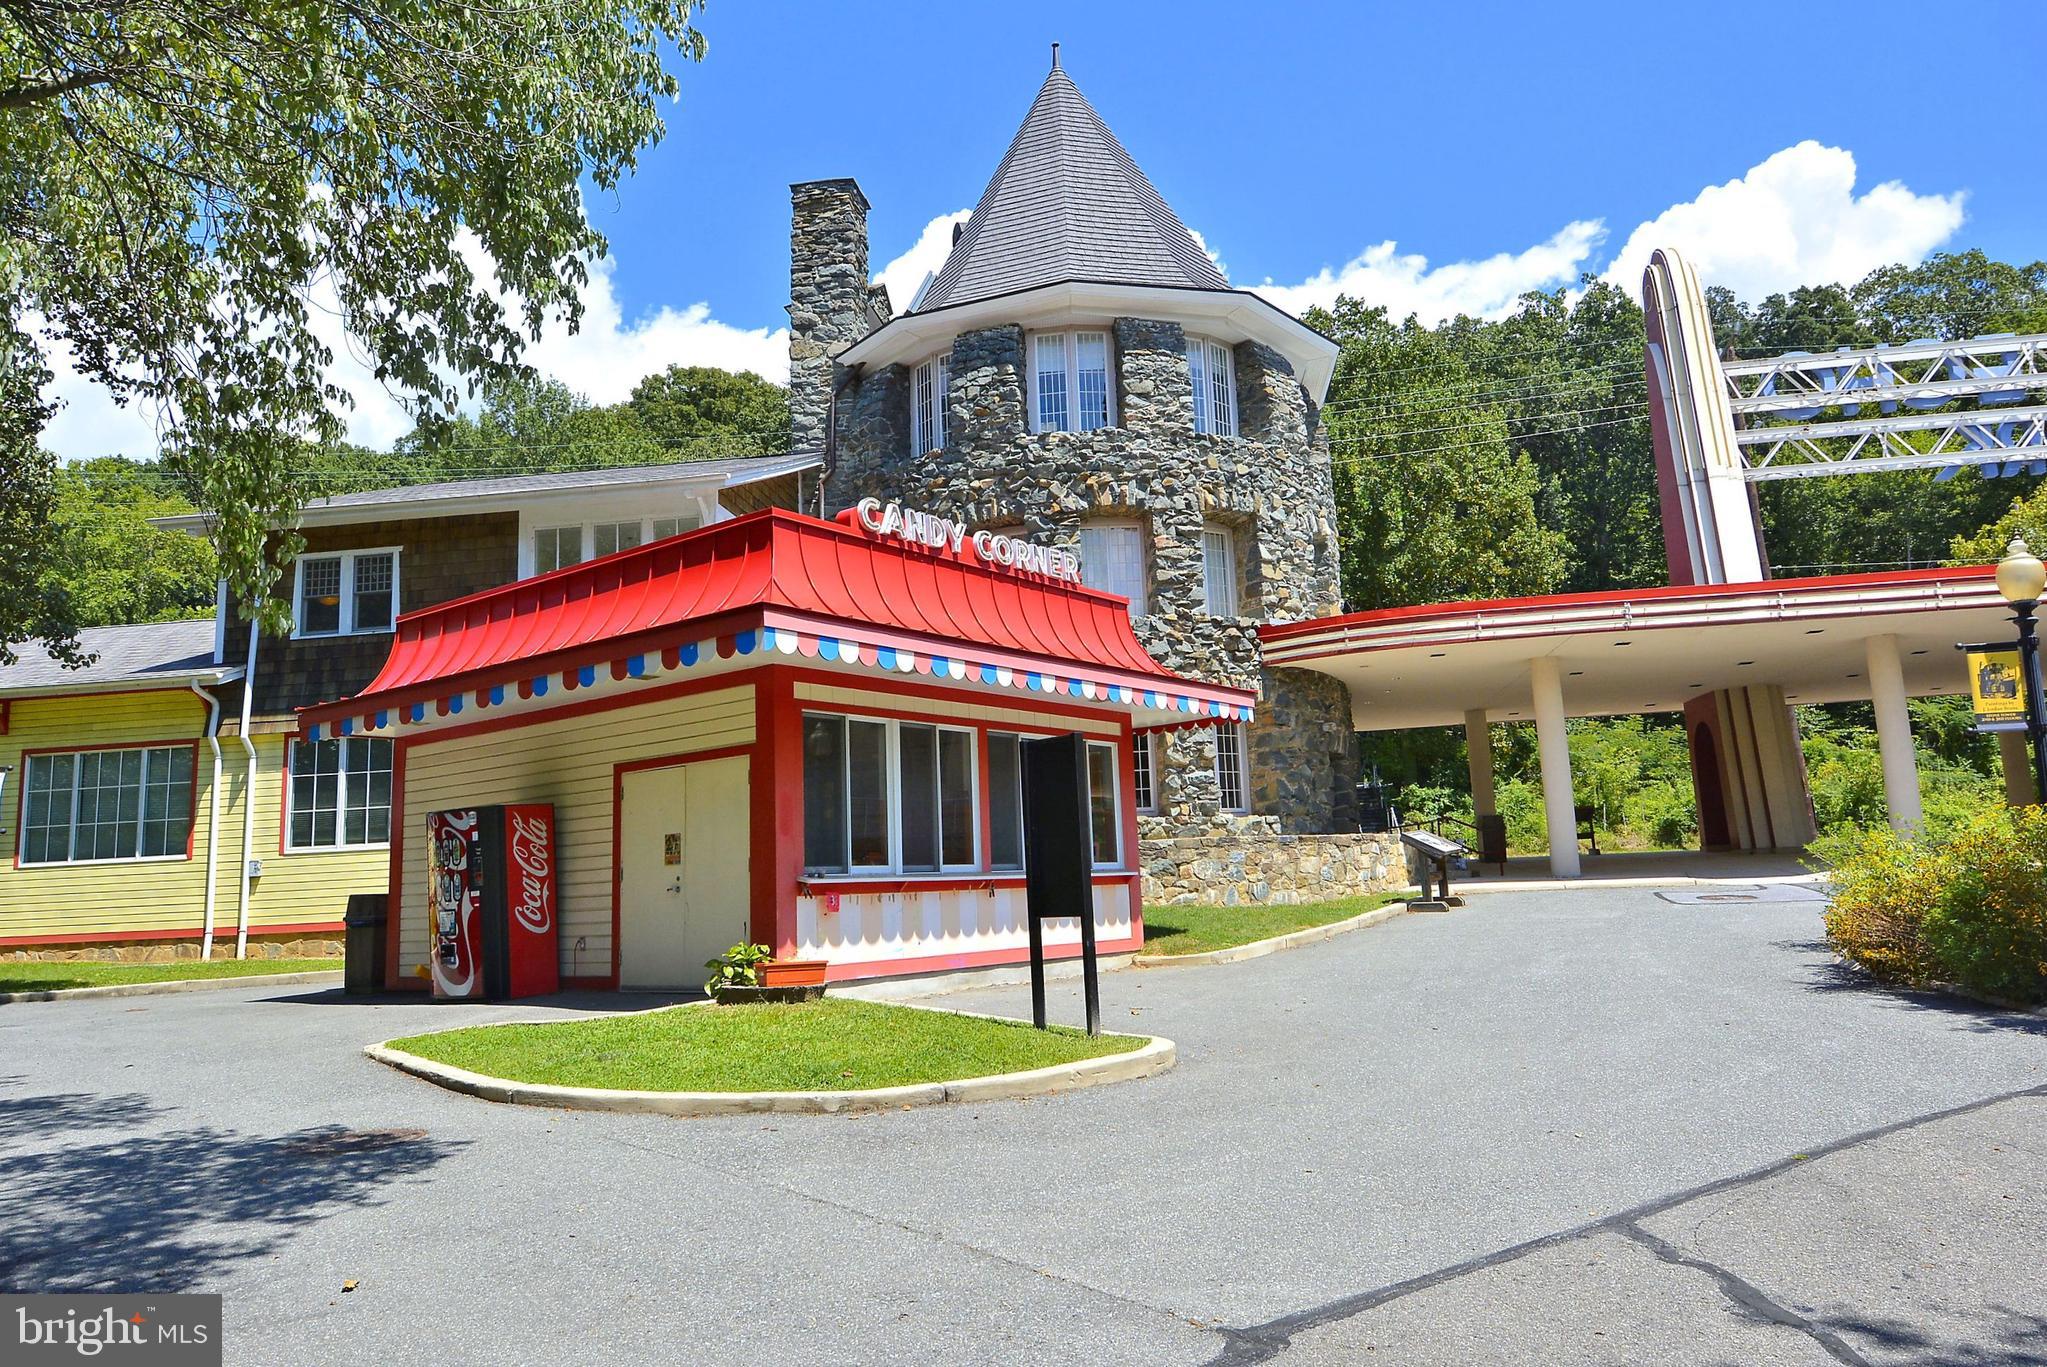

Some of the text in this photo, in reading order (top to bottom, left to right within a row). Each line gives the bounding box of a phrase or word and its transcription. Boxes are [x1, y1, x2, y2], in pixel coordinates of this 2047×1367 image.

[857, 496, 1081, 584] CANDY CORNER
[513, 812, 550, 934] Coca-Cola
